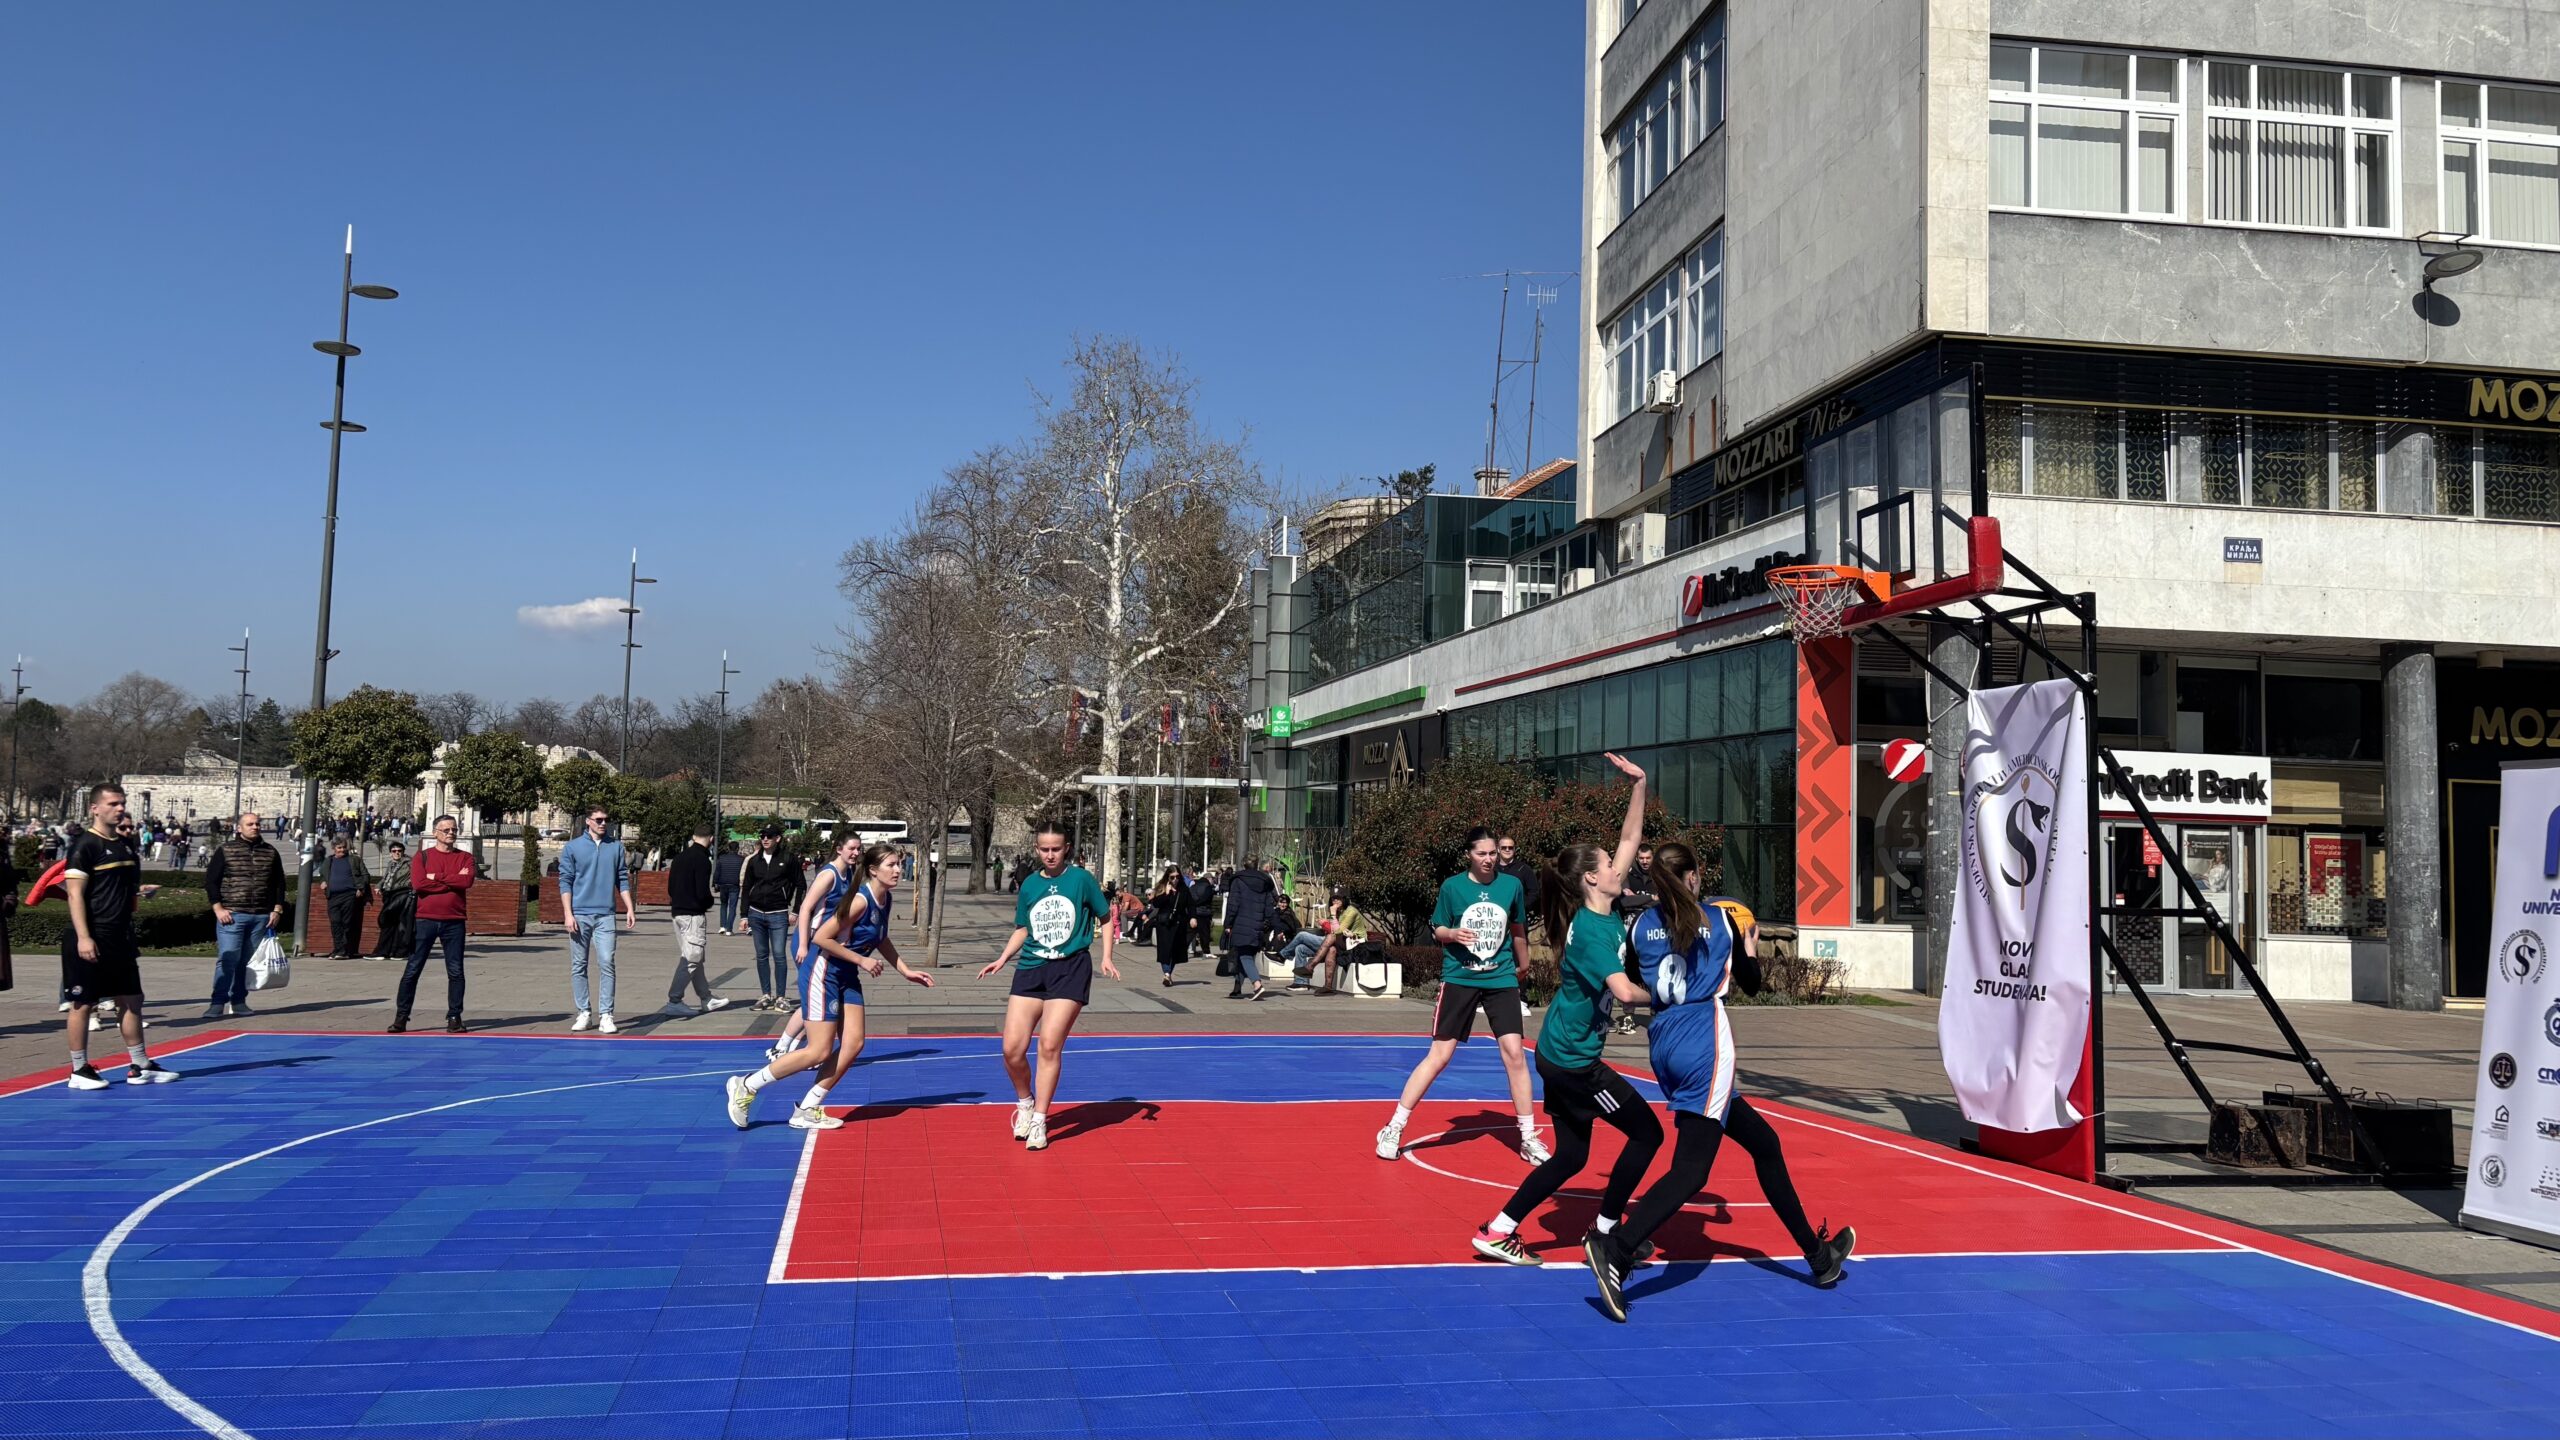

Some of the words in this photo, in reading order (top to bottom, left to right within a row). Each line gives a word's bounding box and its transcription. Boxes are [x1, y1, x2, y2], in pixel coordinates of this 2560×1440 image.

[1713, 418, 1798, 489] MOZZART
[2229, 544, 2258, 553] КРАЉА
[2226, 551, 2260, 560] МИЛАНА
[1273, 724, 1289, 733] 0-24
[2197, 769, 2269, 805] Bank
[1472, 940, 1497, 953] NOVA
[1816, 942, 1826, 956] P
[1657, 953, 1687, 1005] 8
